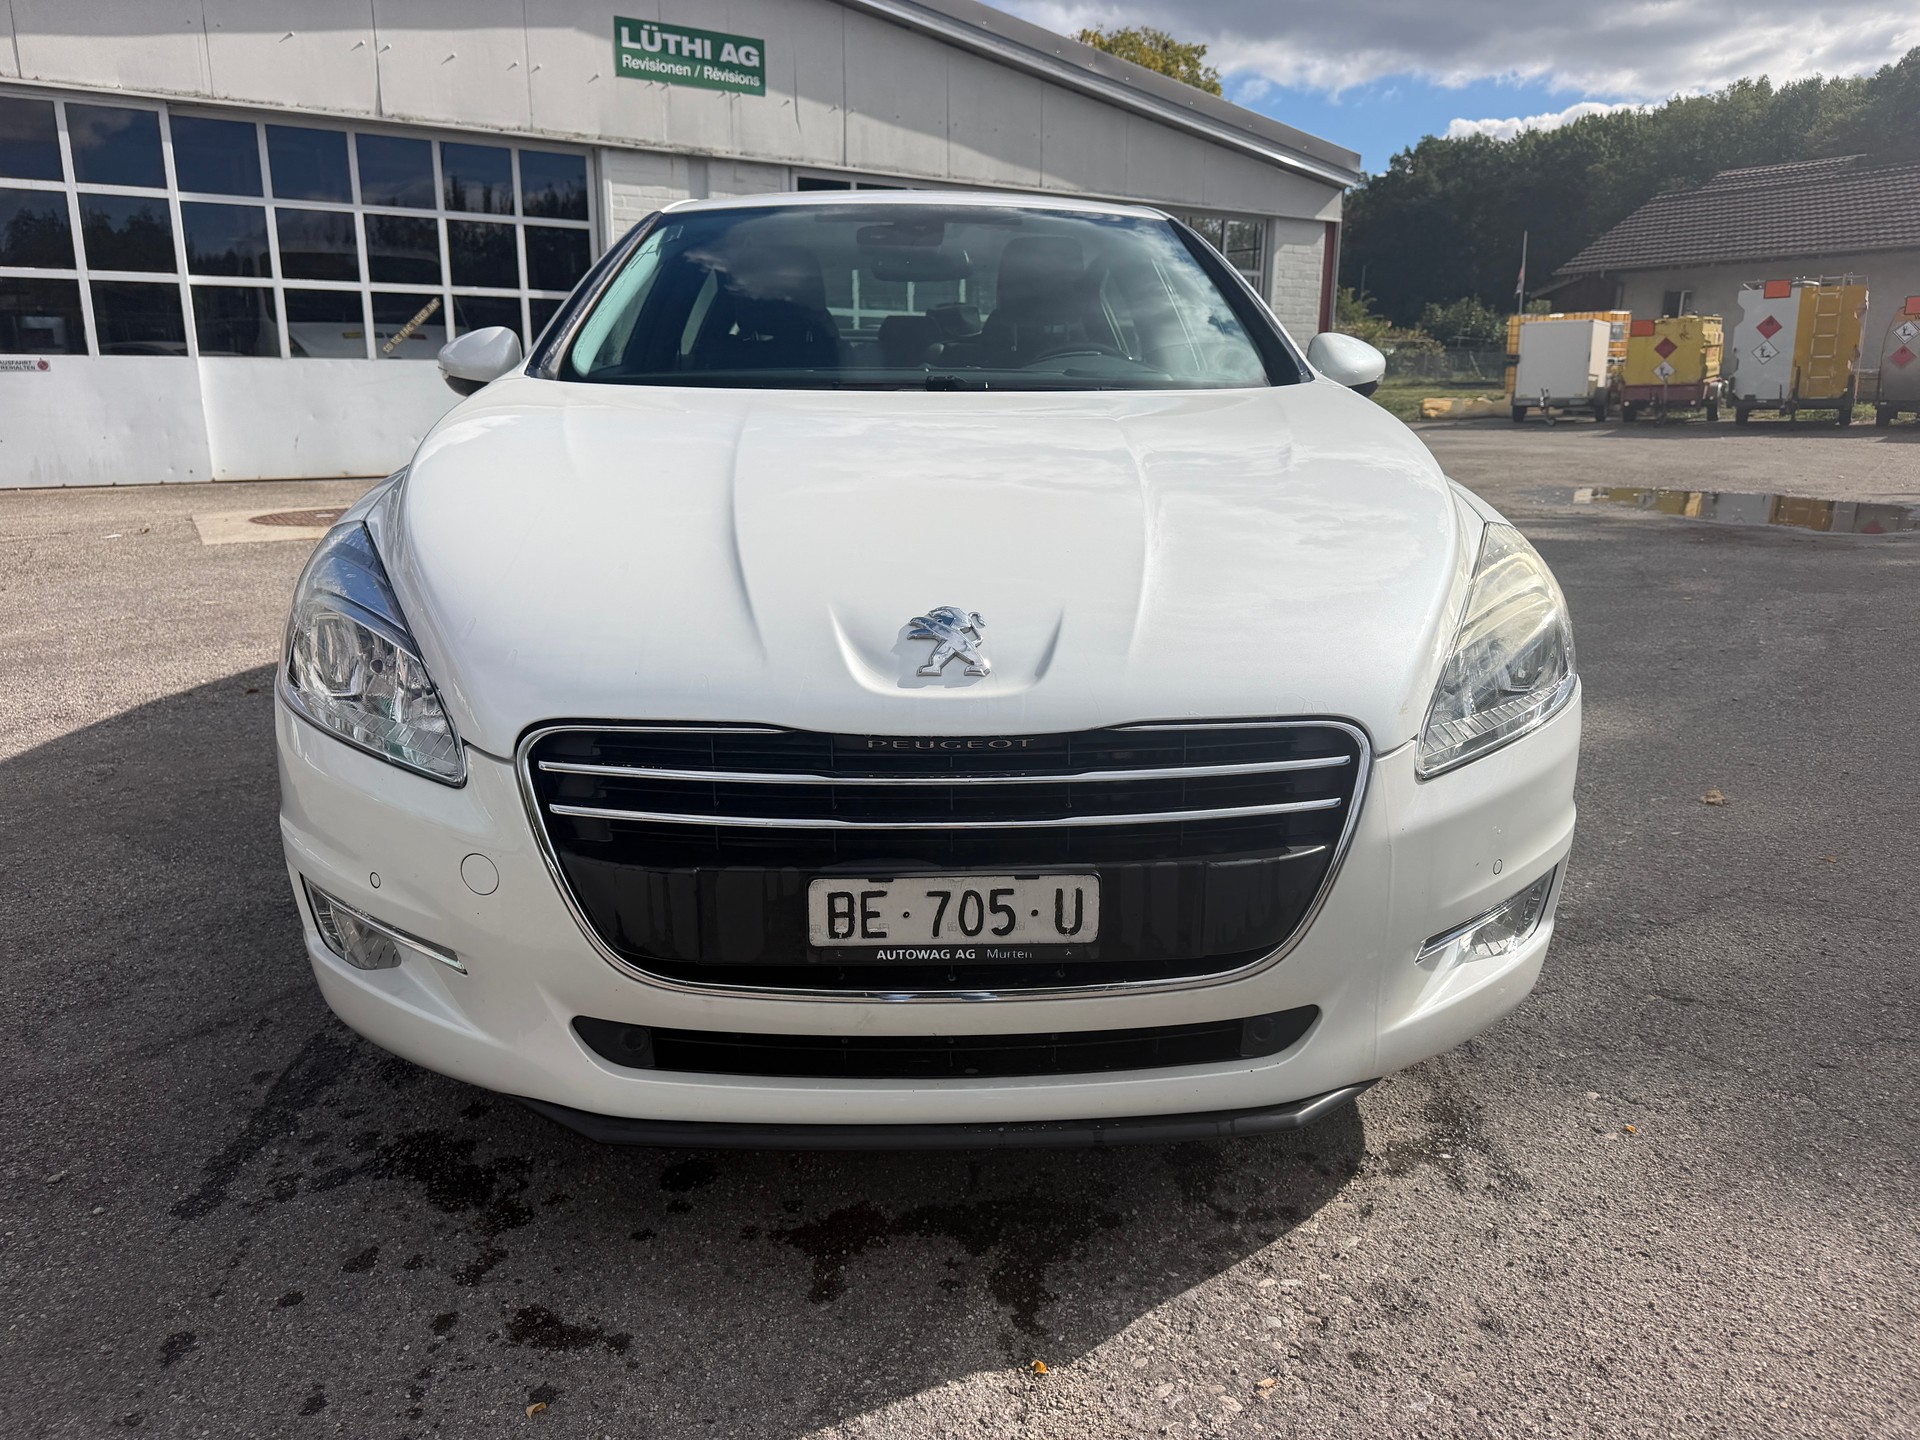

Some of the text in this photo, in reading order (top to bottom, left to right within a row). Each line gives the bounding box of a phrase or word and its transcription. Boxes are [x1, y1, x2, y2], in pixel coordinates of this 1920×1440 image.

[620, 24, 760, 67] LÜTHI AG
[622, 54, 760, 87] Revisionen / Révisions
[867, 738, 1035, 749] PEUGEOT
[827, 890, 888, 939] BE
[926, 888, 1016, 937] 705
[1055, 887, 1083, 936] U
[876, 948, 1033, 960] AUTOWAG AG Murten
